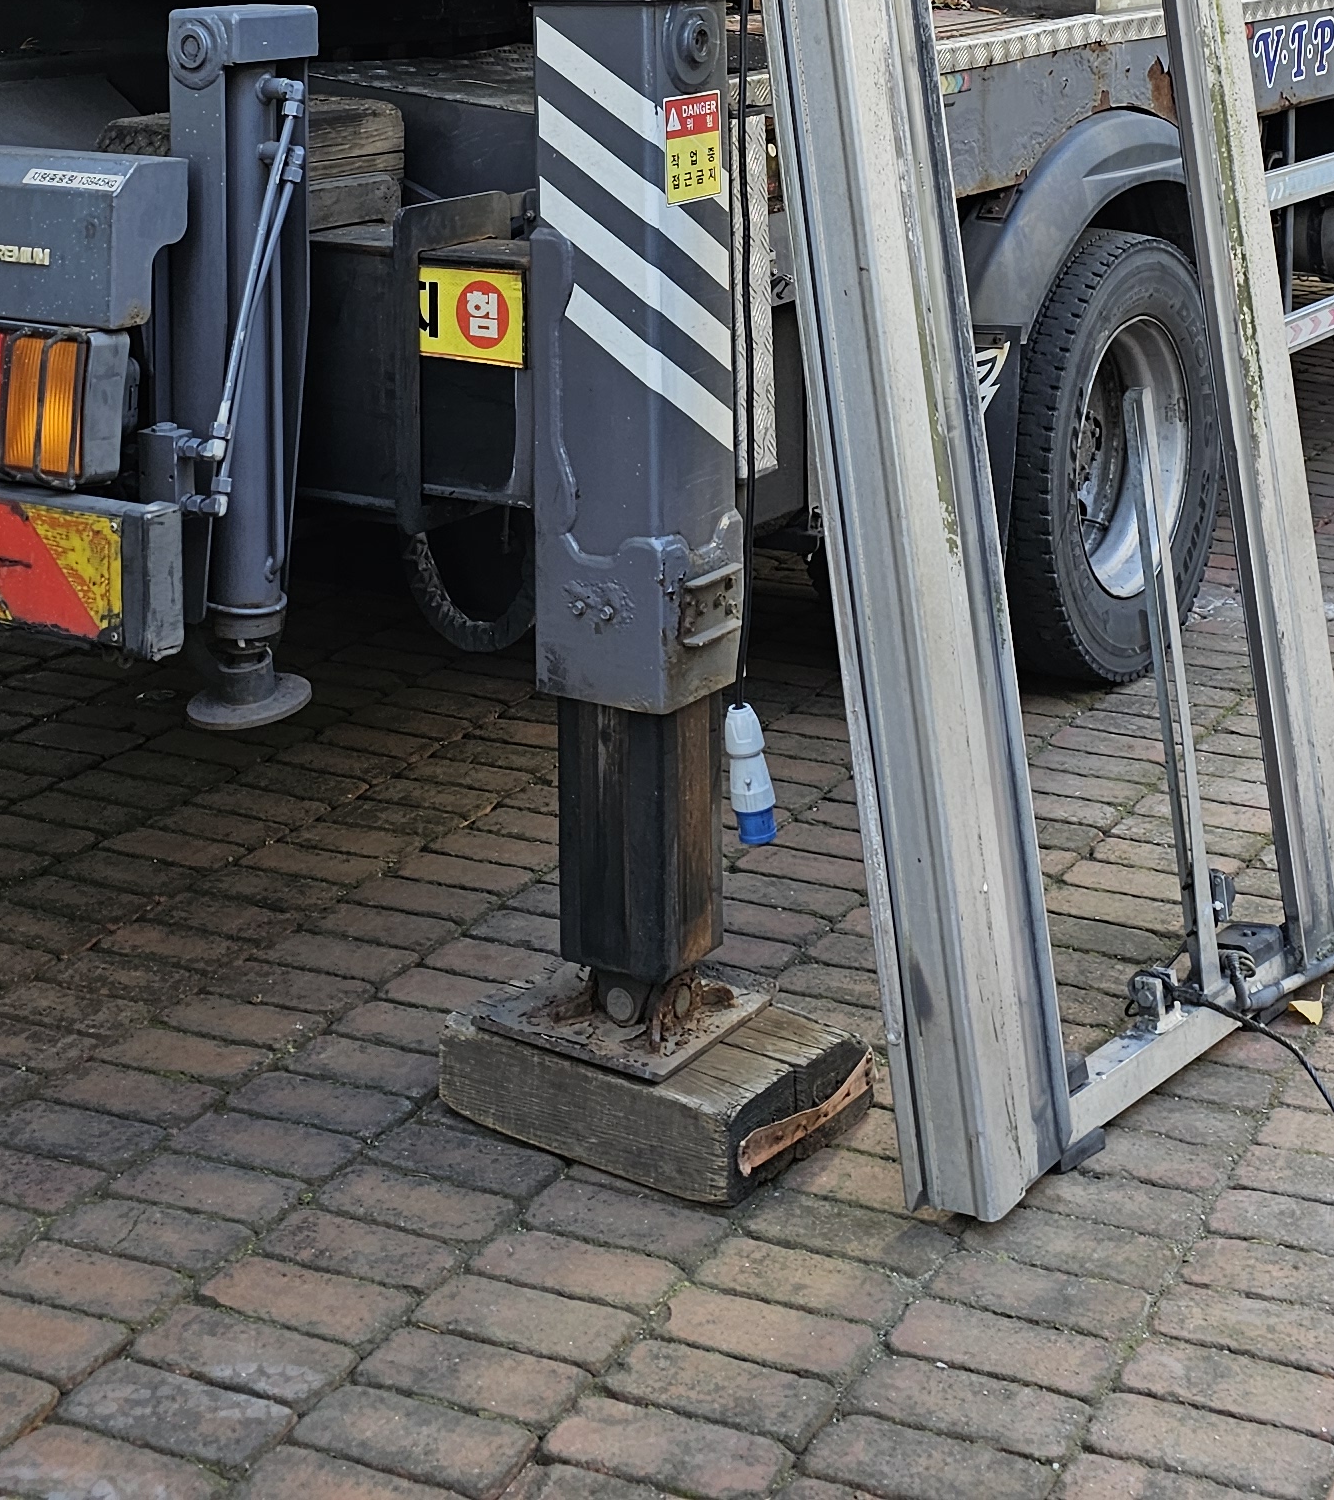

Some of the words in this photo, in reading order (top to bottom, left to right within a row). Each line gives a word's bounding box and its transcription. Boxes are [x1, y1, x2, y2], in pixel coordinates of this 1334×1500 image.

[682, 101, 717, 118] DANGER
[671, 167, 717, 190] 접근금지
[467, 291, 498, 338] 험
